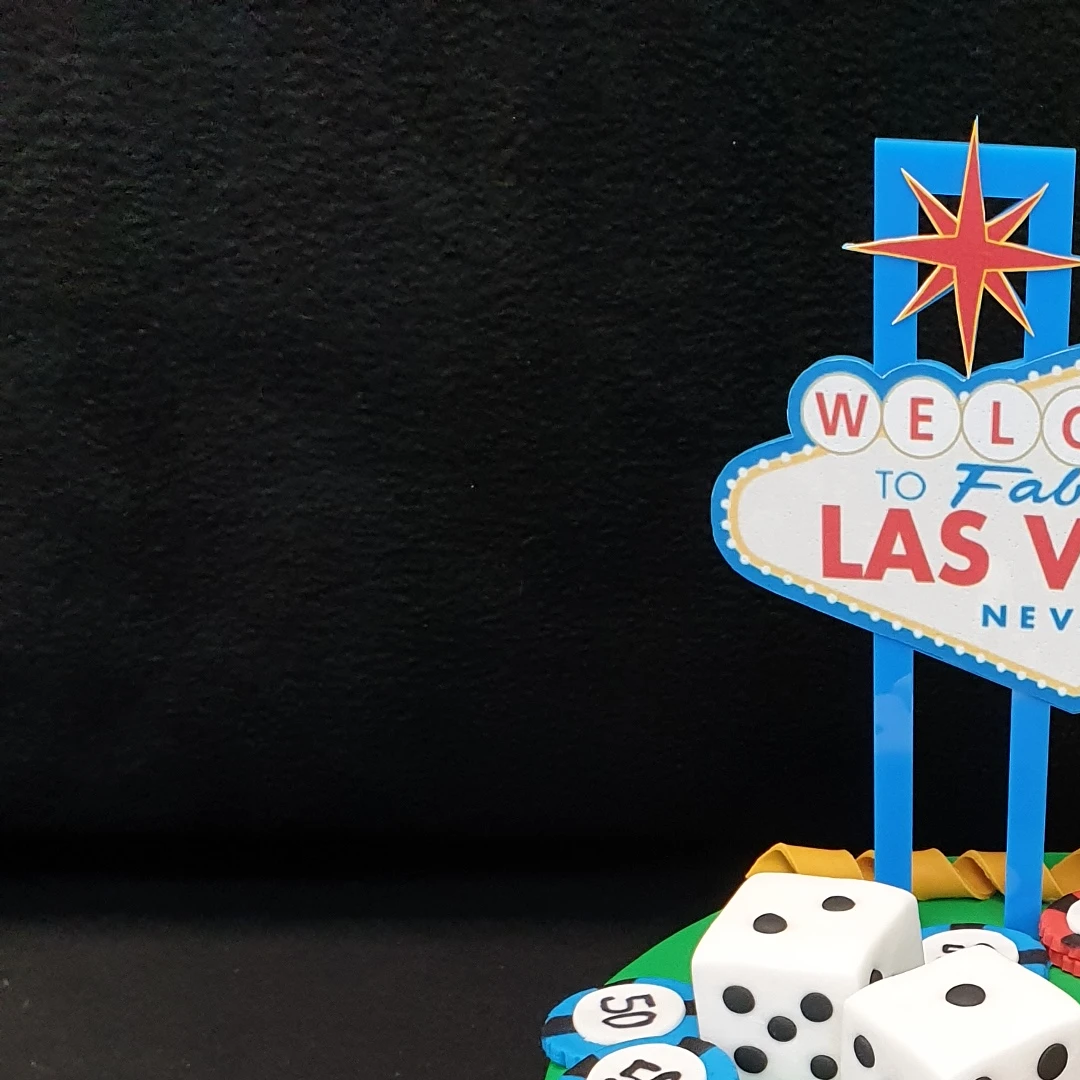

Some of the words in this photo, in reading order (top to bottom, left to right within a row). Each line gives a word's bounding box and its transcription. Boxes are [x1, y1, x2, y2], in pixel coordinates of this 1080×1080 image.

[876, 469, 926, 501] TO
[821, 504, 990, 587] LAS
[600, 993, 658, 1028] 50
